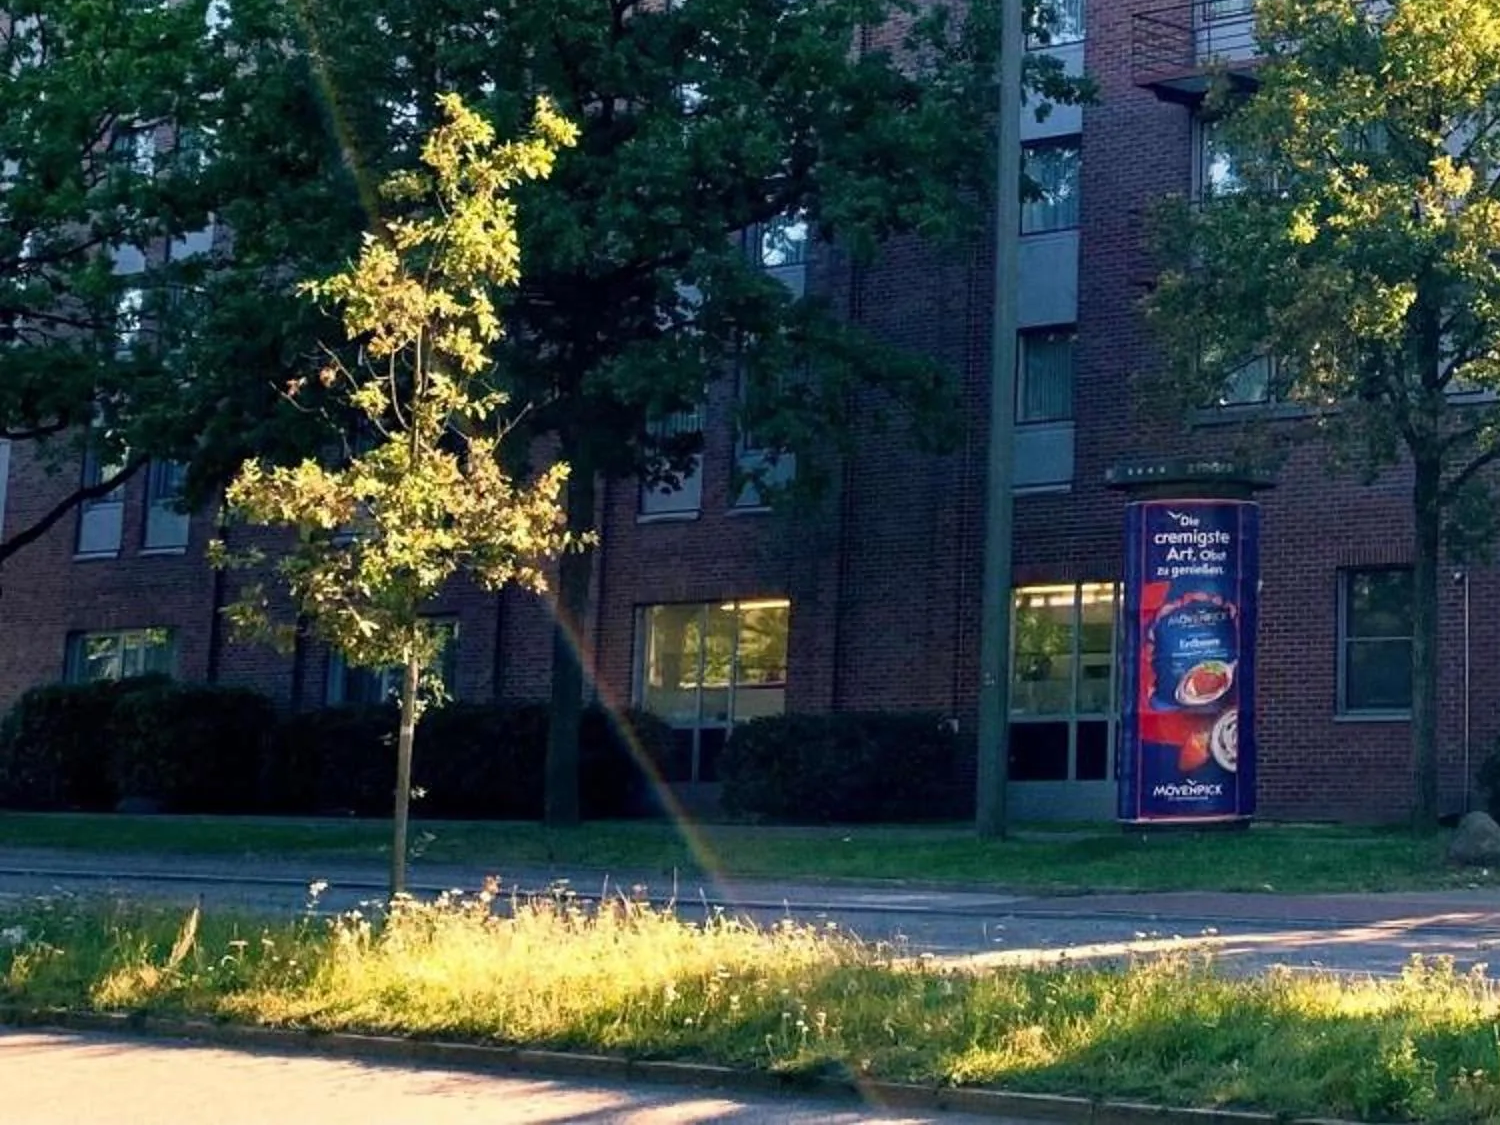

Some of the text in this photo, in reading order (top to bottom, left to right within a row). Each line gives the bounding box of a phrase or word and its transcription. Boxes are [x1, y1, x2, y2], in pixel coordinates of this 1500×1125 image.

[1180, 515, 1200, 526] Die
[1154, 529, 1230, 547] cremigste
[1166, 547, 1197, 561] Art.
[1153, 783, 1222, 796] MÖVENPICK
